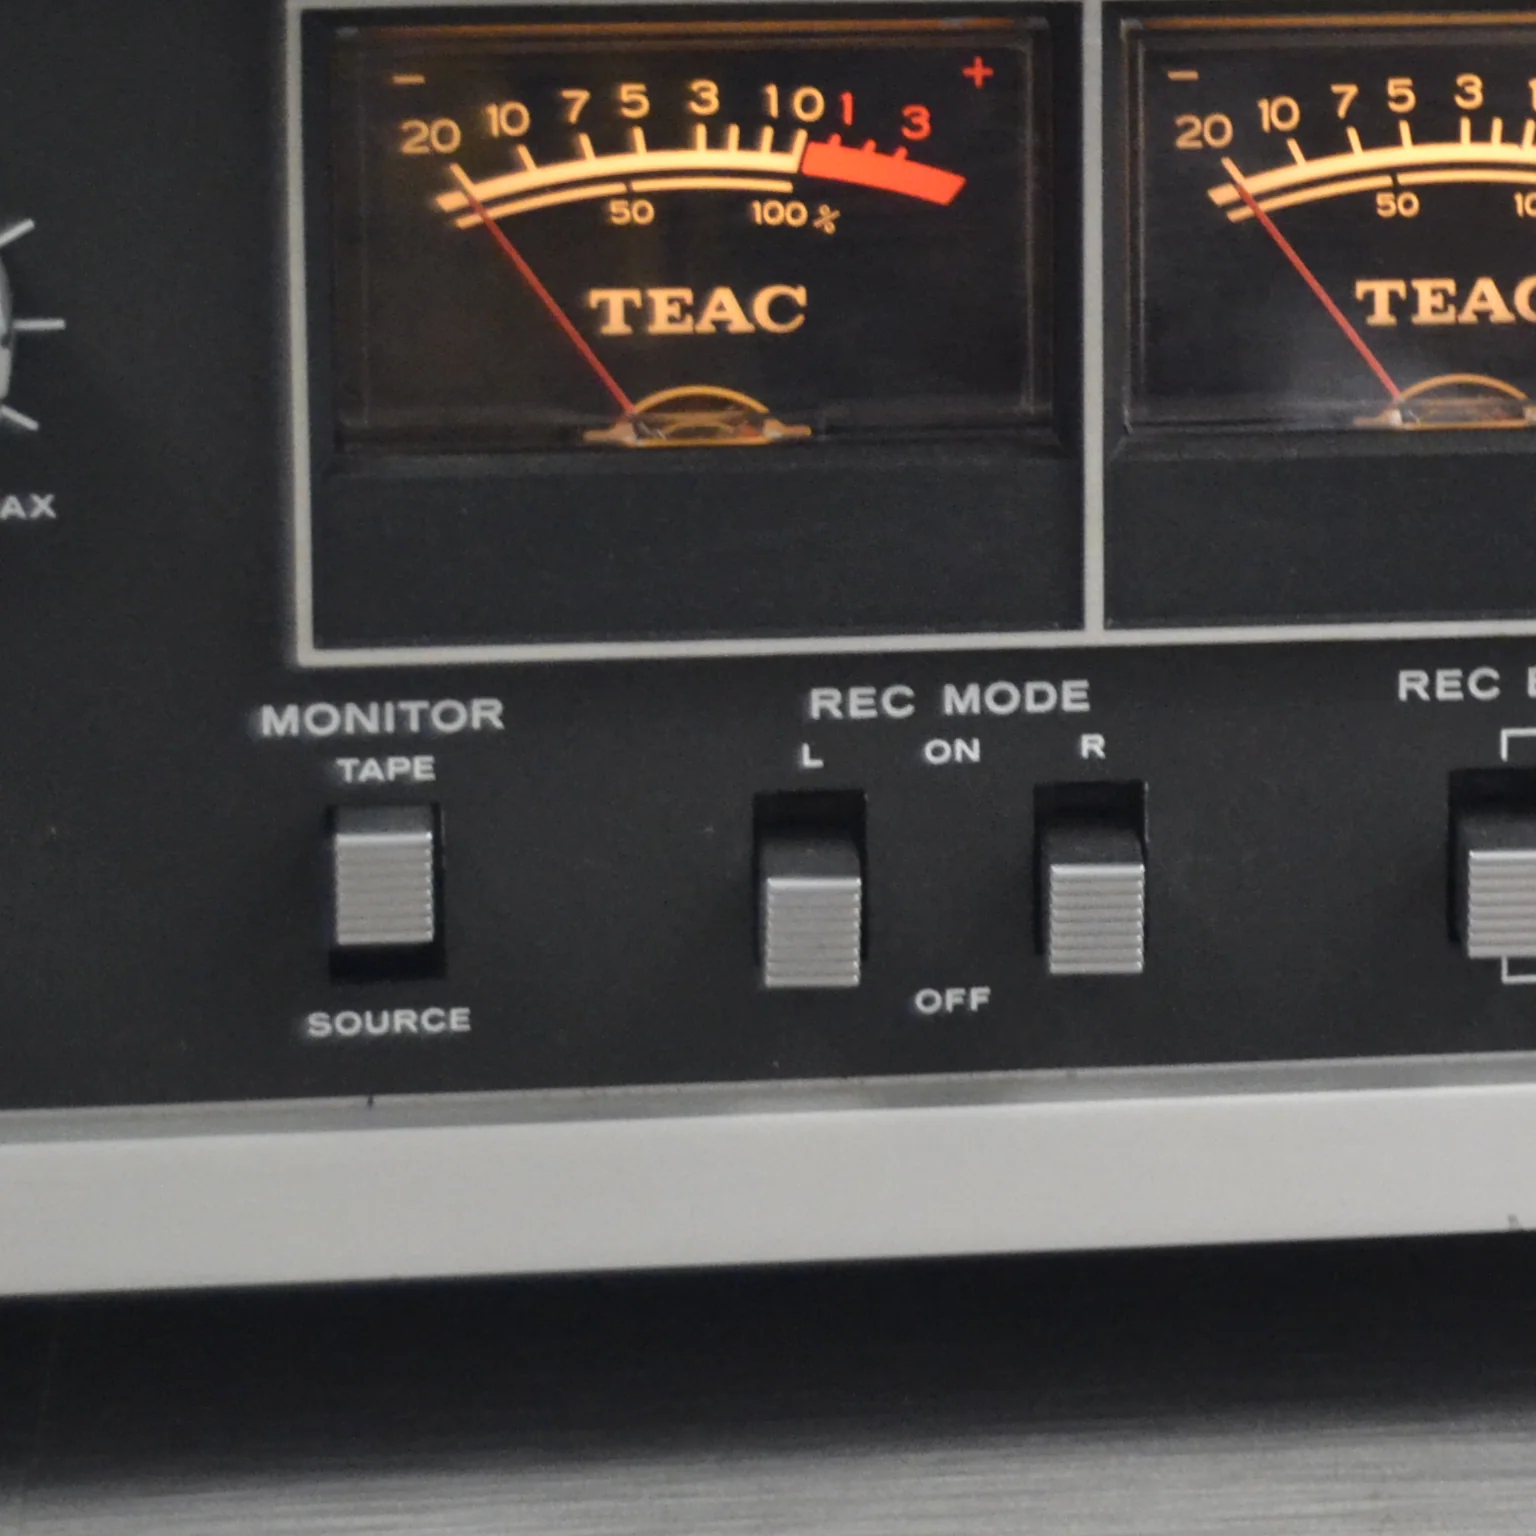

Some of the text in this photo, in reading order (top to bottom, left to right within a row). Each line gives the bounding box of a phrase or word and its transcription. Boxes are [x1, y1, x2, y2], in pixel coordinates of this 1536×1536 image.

[400, 79, 932, 155] 20 10 7 5 3 1 0 1 3
[1175, 113, 1234, 149] 20
[1257, 95, 1301, 133] 10
[1330, 83, 1359, 119] 7
[1386, 77, 1417, 114] 5
[1454, 73, 1484, 110] 3
[608, 198, 655, 226] 50
[1375, 191, 1420, 218] 50
[587, 284, 807, 336] TEAC
[1397, 666, 1500, 702] REC
[808, 679, 1091, 720] REC MODE
[258, 698, 504, 738] MONITOR
[799, 742, 824, 769] L
[923, 737, 981, 765] ON
[1079, 733, 1106, 759] R
[335, 755, 436, 783] TAPE
[913, 986, 991, 1015] OFF
[306, 1006, 471, 1038] SOURCE
